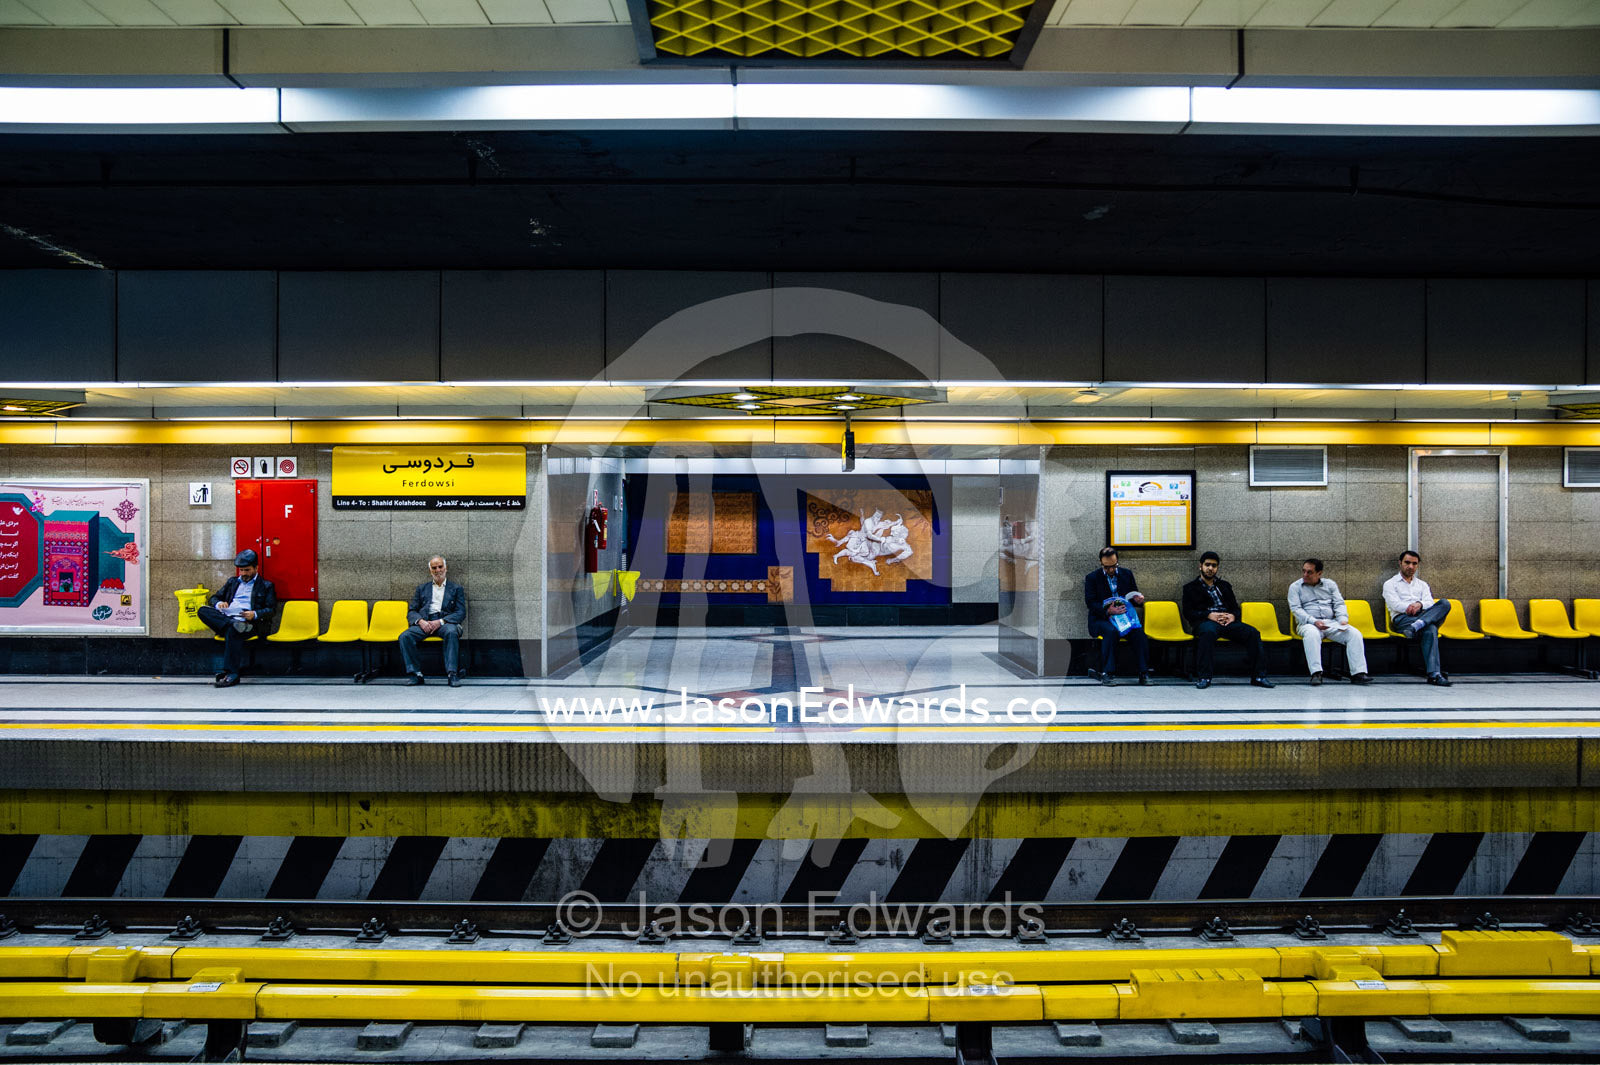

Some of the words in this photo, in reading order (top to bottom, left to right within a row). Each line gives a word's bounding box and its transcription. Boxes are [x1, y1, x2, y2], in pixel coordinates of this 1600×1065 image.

[383, 454, 475, 474] فردوسی
[402, 479, 455, 488] Ferdowsi
[284, 504, 293, 518] F
